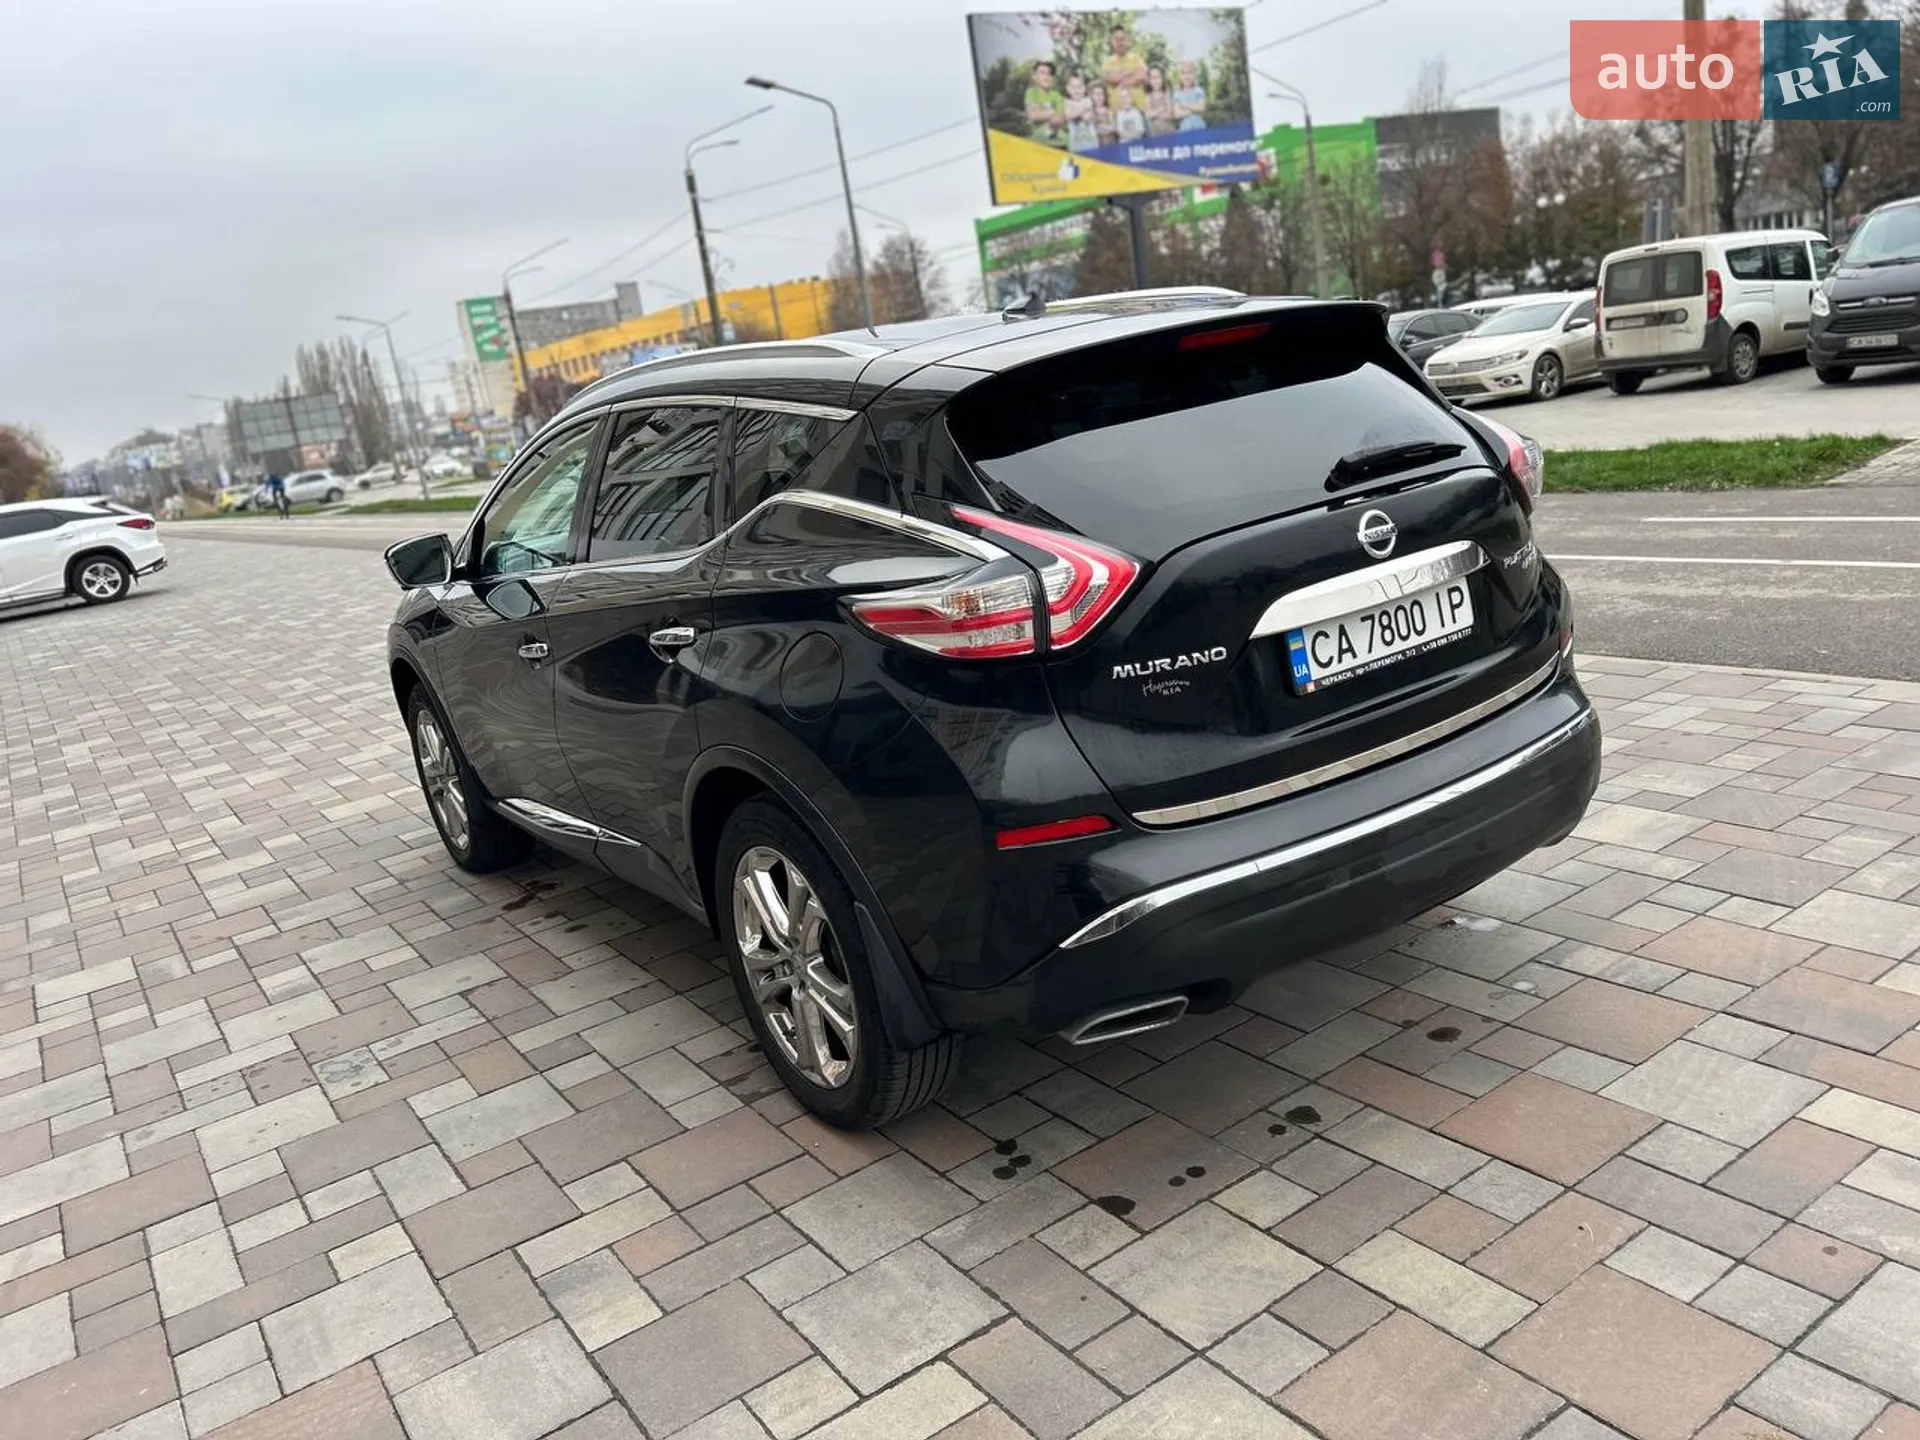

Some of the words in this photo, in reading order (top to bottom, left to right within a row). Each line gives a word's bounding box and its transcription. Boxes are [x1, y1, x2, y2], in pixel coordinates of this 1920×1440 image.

[1364, 526, 1396, 541] NISSAN
[1311, 623, 1358, 669] CA
[1361, 599, 1427, 654] 7800
[1435, 585, 1465, 628] IP
[1112, 646, 1227, 679] MURANO
[1293, 664, 1309, 678] UA
